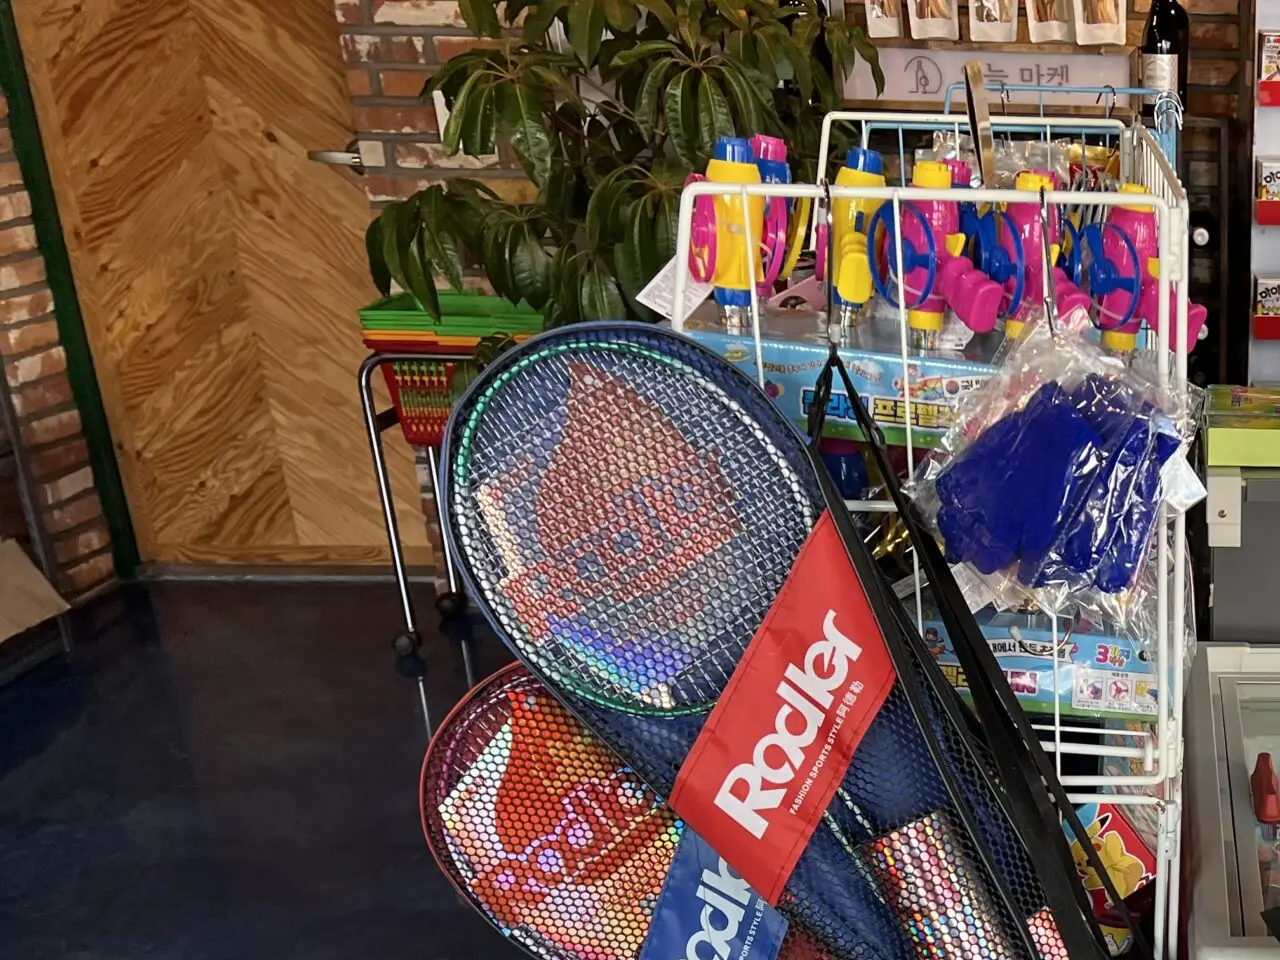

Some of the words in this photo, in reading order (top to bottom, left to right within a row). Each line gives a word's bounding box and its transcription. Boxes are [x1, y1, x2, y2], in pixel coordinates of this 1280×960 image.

[790, 780, 812, 815] FASHION
[809, 744, 831, 778] SPORTS
[828, 717, 844, 744] STYLE
[750, 910, 763, 936] STYLE
